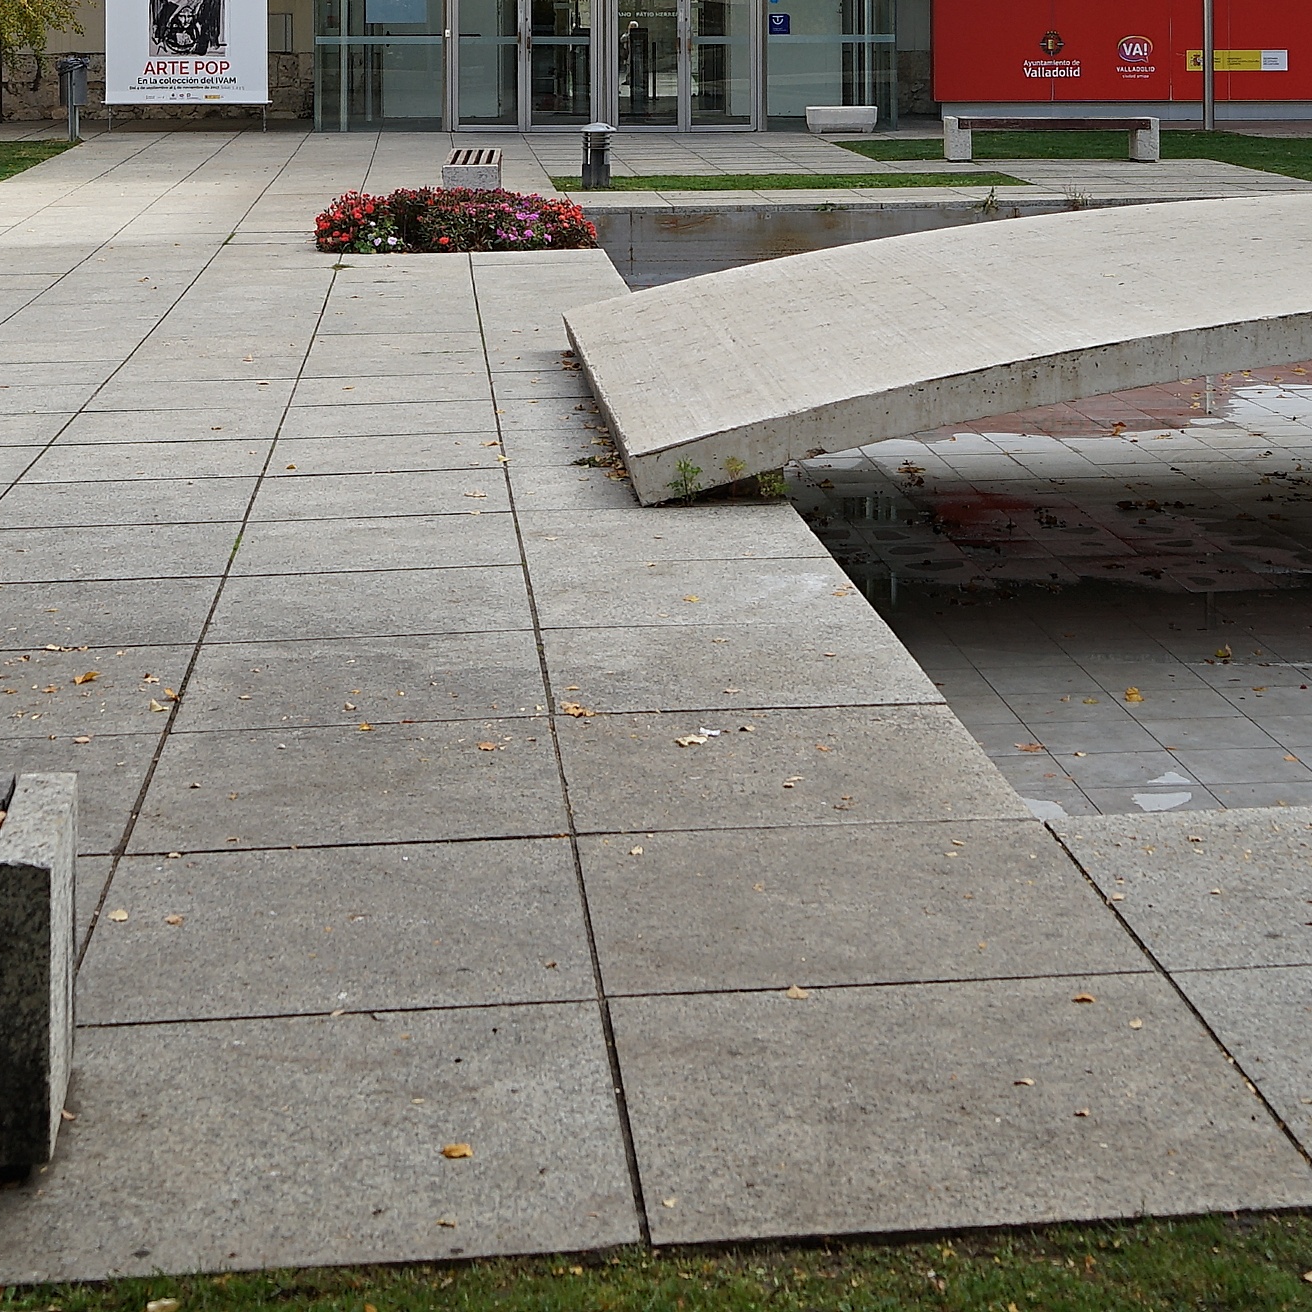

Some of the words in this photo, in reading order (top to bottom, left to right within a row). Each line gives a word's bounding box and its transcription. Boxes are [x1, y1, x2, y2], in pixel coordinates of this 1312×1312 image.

[1122, 42, 1148, 56] VA!
[143, 61, 190, 75] ARTE
[194, 61, 230, 75] POP
[1023, 59, 1071, 67] Ayuntamiento
[1023, 67, 1081, 78] Valladolid
[137, 77, 148, 85] En
[159, 77, 199, 85] colección
